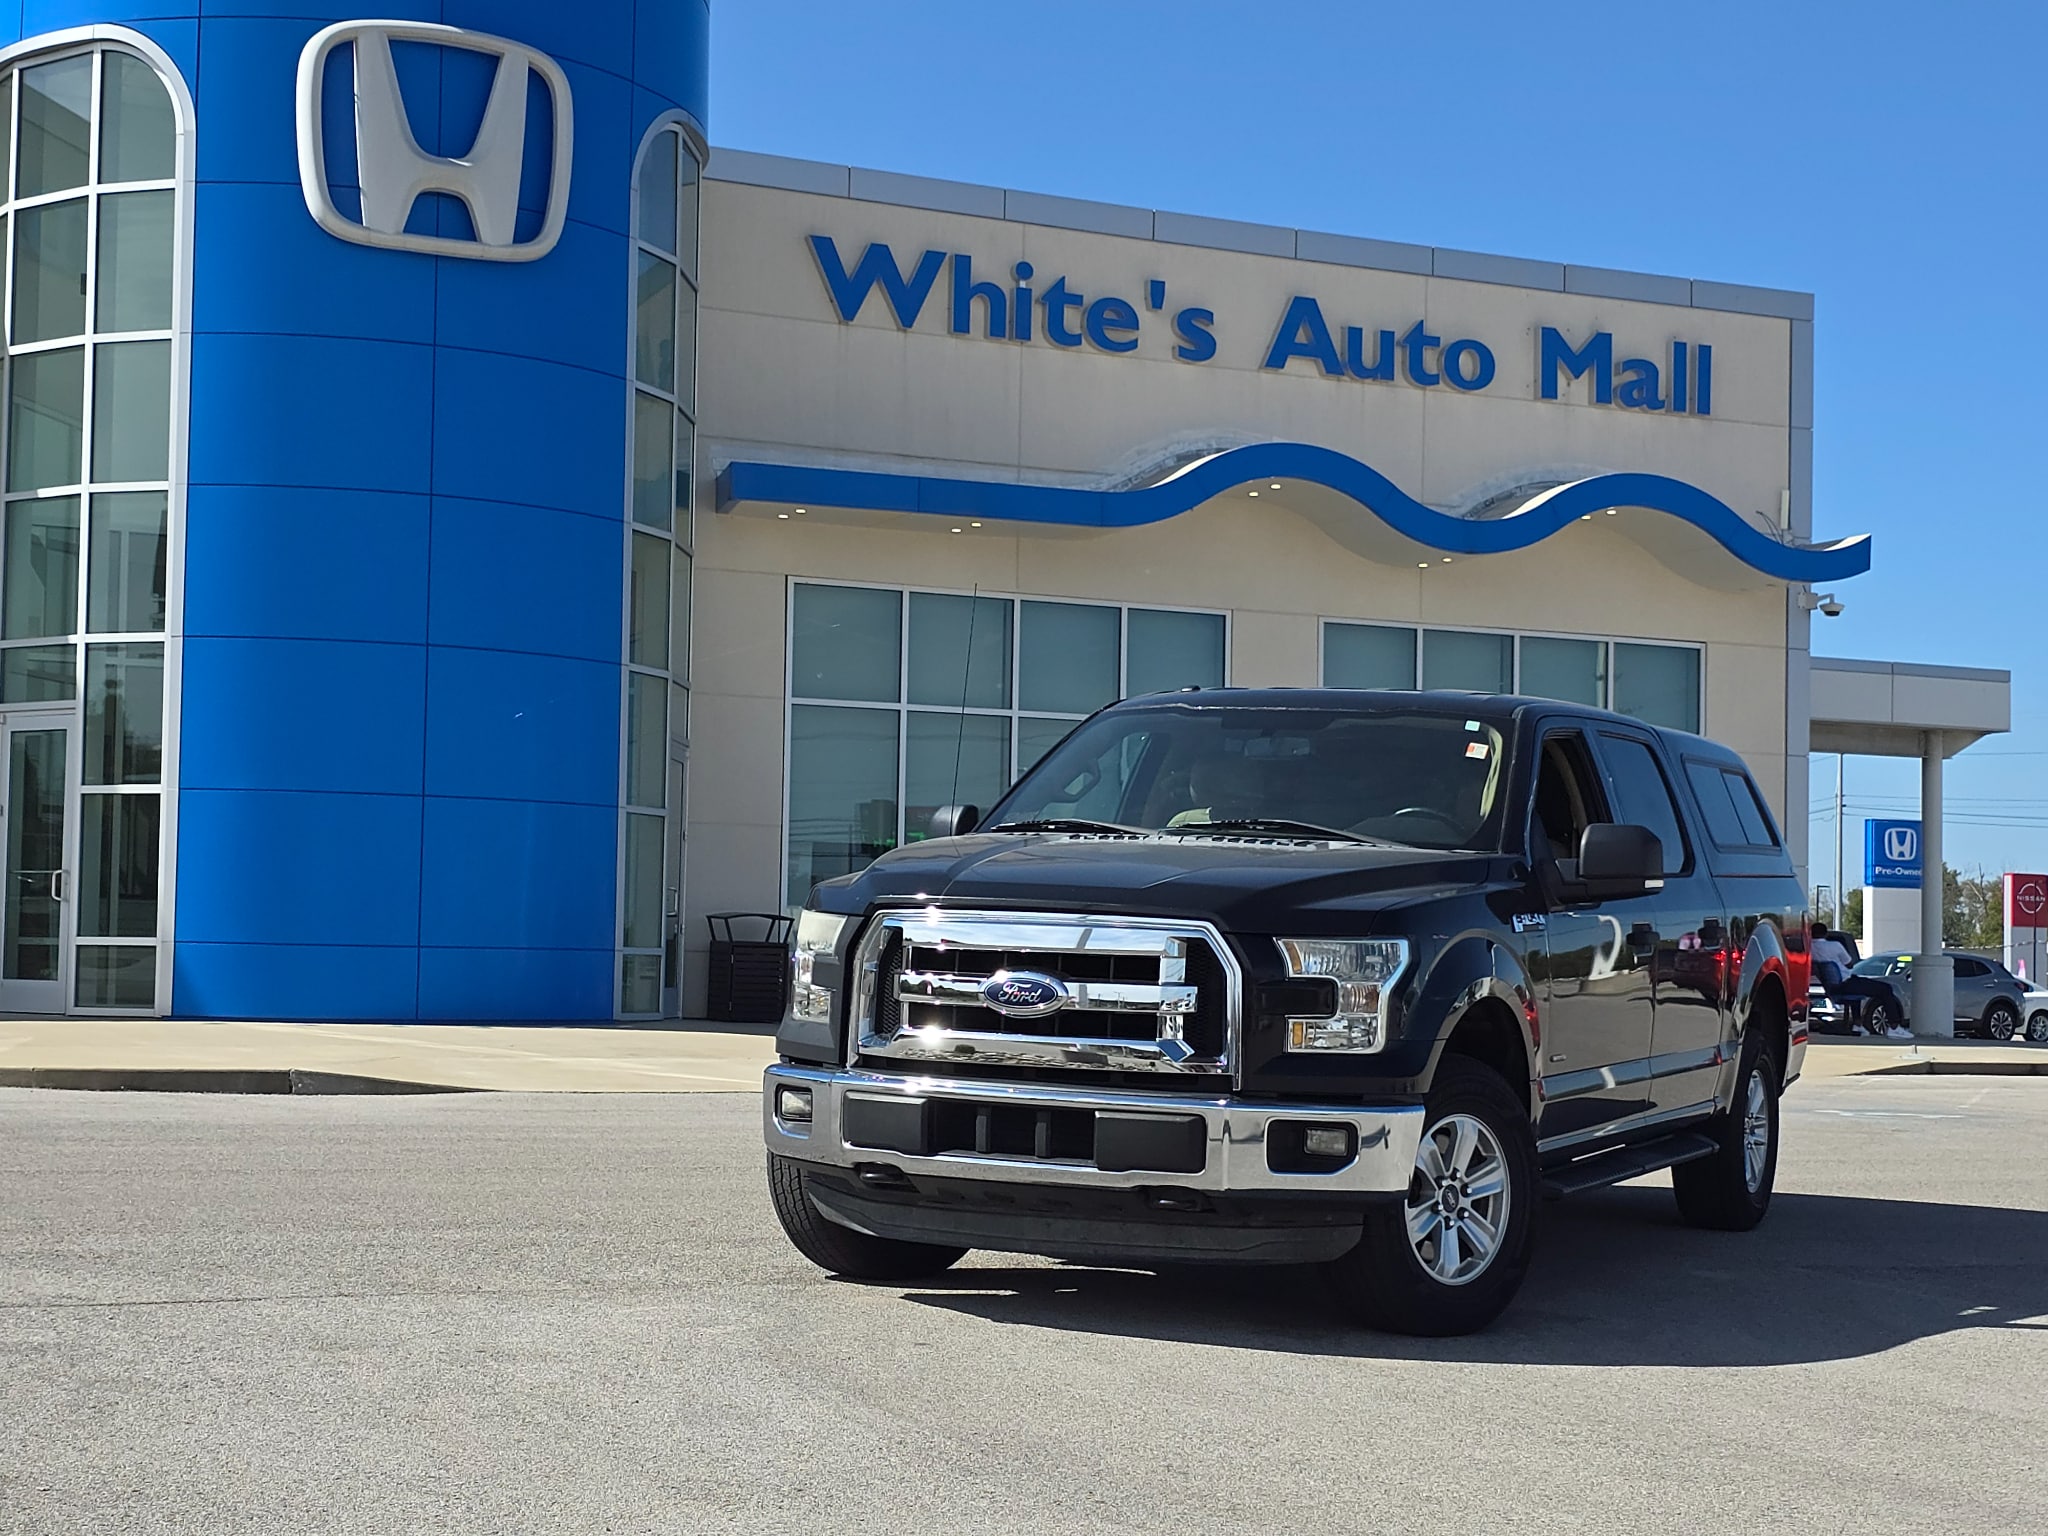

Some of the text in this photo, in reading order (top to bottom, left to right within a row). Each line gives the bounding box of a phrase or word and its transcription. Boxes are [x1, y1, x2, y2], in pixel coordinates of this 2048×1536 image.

[806, 234, 1713, 417] White's Auto Mall
[998, 981, 1042, 1003] Ford
